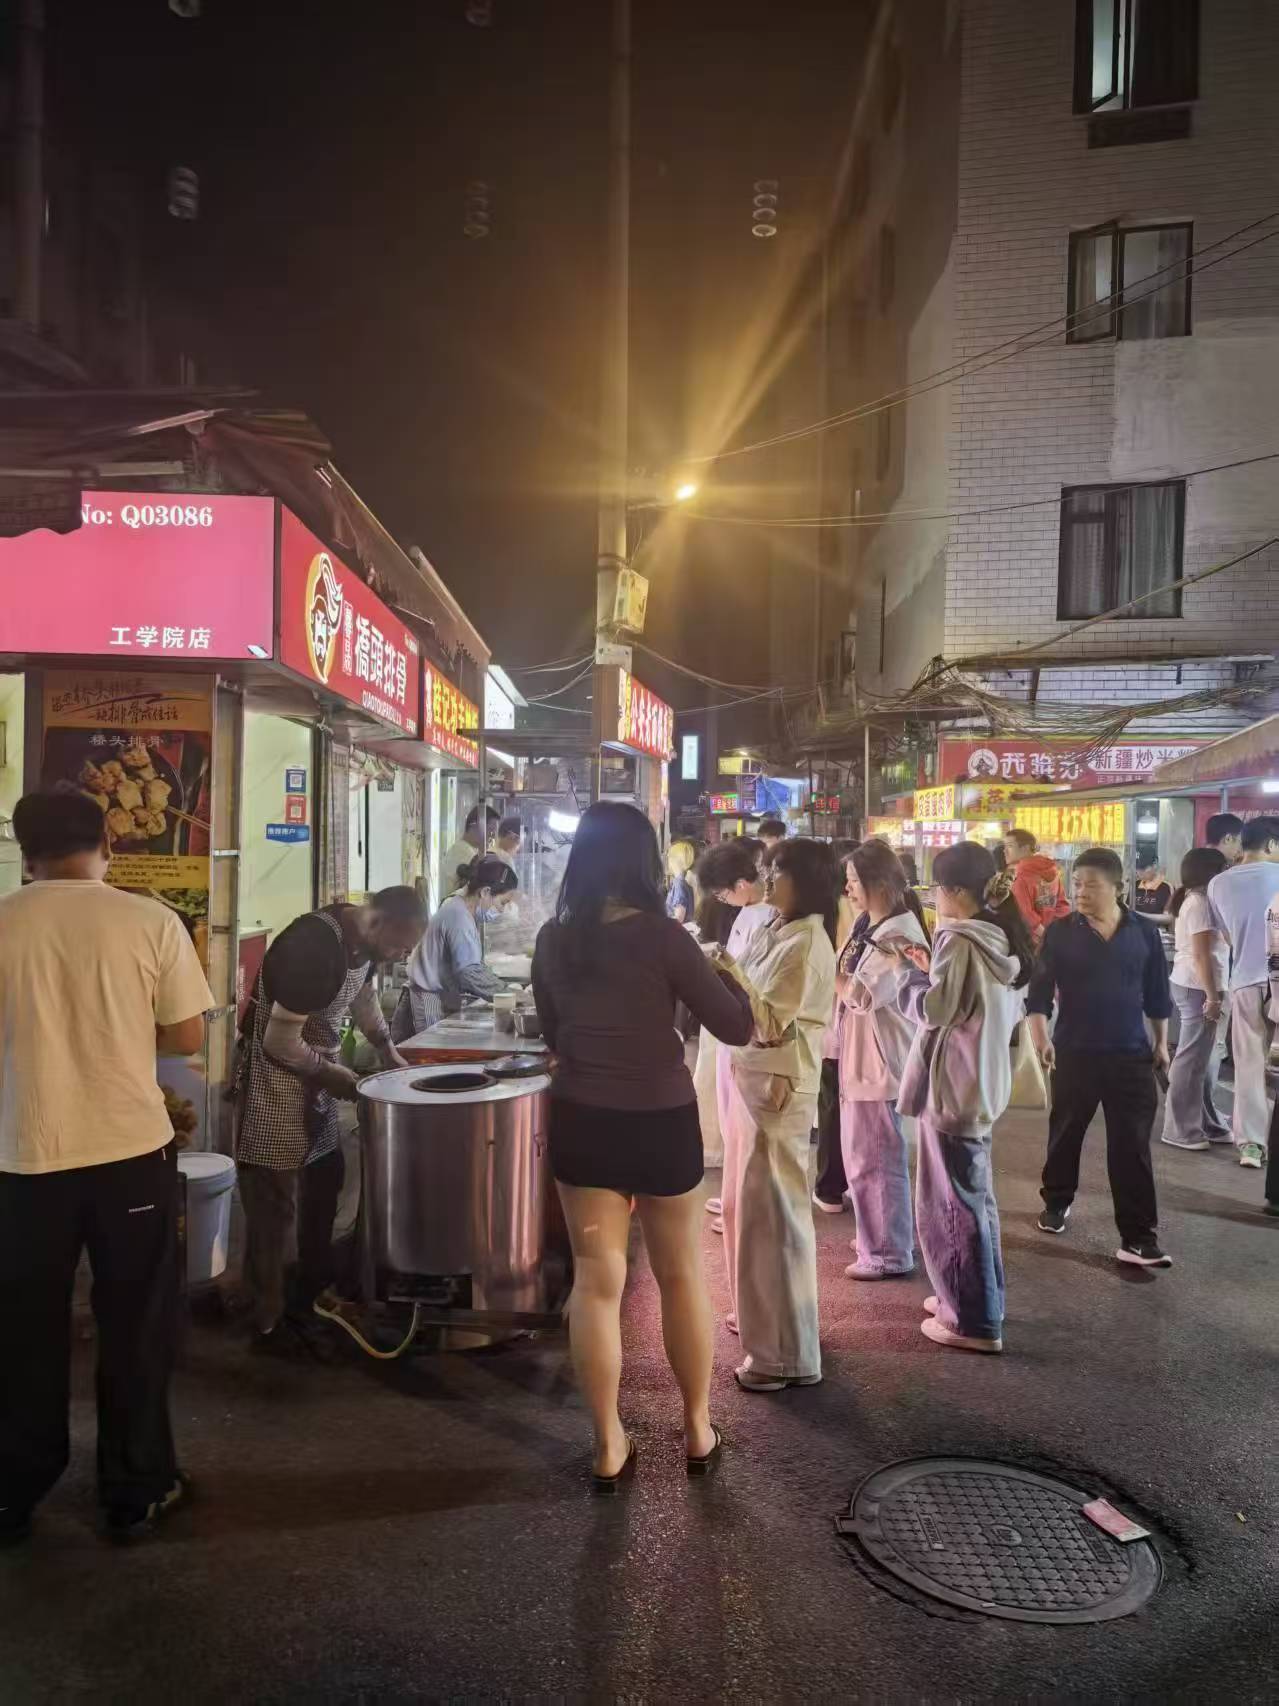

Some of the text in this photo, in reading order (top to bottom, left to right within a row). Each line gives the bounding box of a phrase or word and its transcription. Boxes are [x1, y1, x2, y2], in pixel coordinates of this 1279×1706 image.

[121, 504, 213, 528] Q03086
[110, 626, 211, 648] 工学院店
